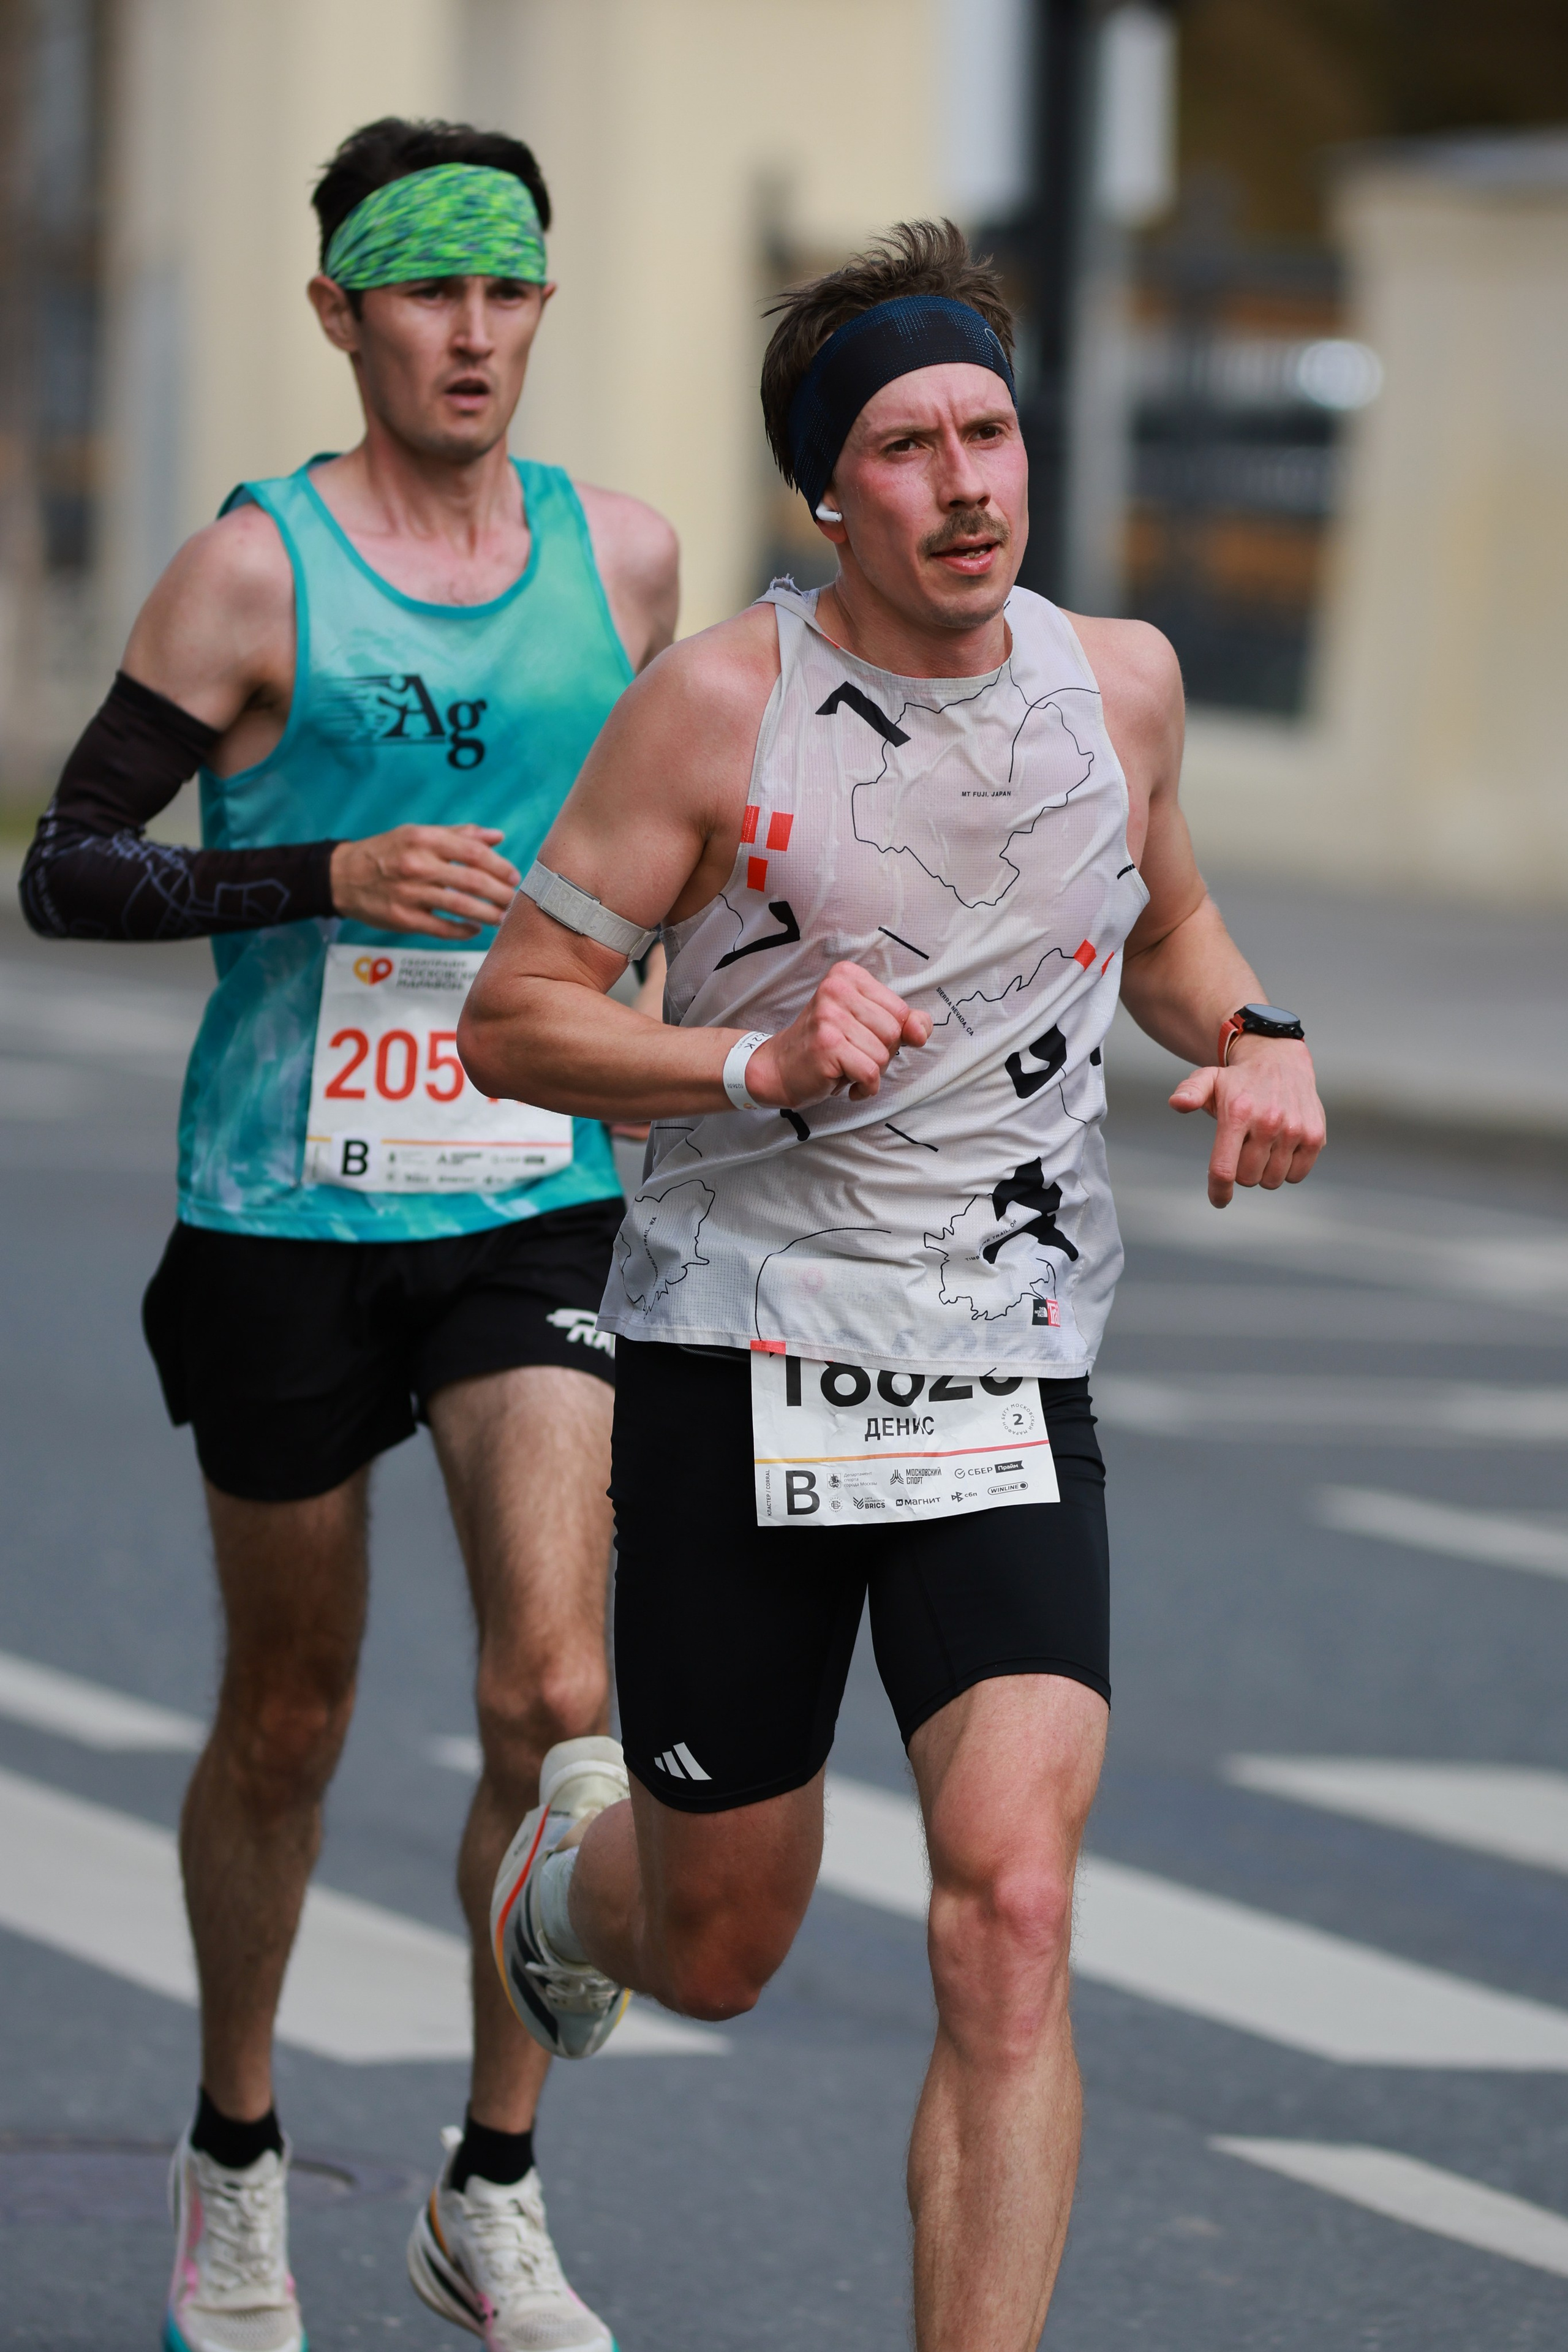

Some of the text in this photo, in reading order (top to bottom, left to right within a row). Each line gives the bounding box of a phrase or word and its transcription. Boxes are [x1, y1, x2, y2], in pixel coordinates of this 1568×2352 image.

[379, 673, 488, 771] Ag
[936, 987, 974, 1036] SIERRA NEVADA, CA
[341, 1140, 369, 1175] B
[649, 1216, 657, 1226] WA
[1010, 1219, 1017, 1228] OR
[1012, 1413, 1023, 1425] 2
[864, 1416, 934, 1442] ДЕНИС
[906, 1466, 941, 1476] МОСКОВСКИЙ
[968, 1466, 993, 1476] СБЕР
[785, 1470, 820, 1515] B
[990, 1484, 1019, 1493] WINLINE
